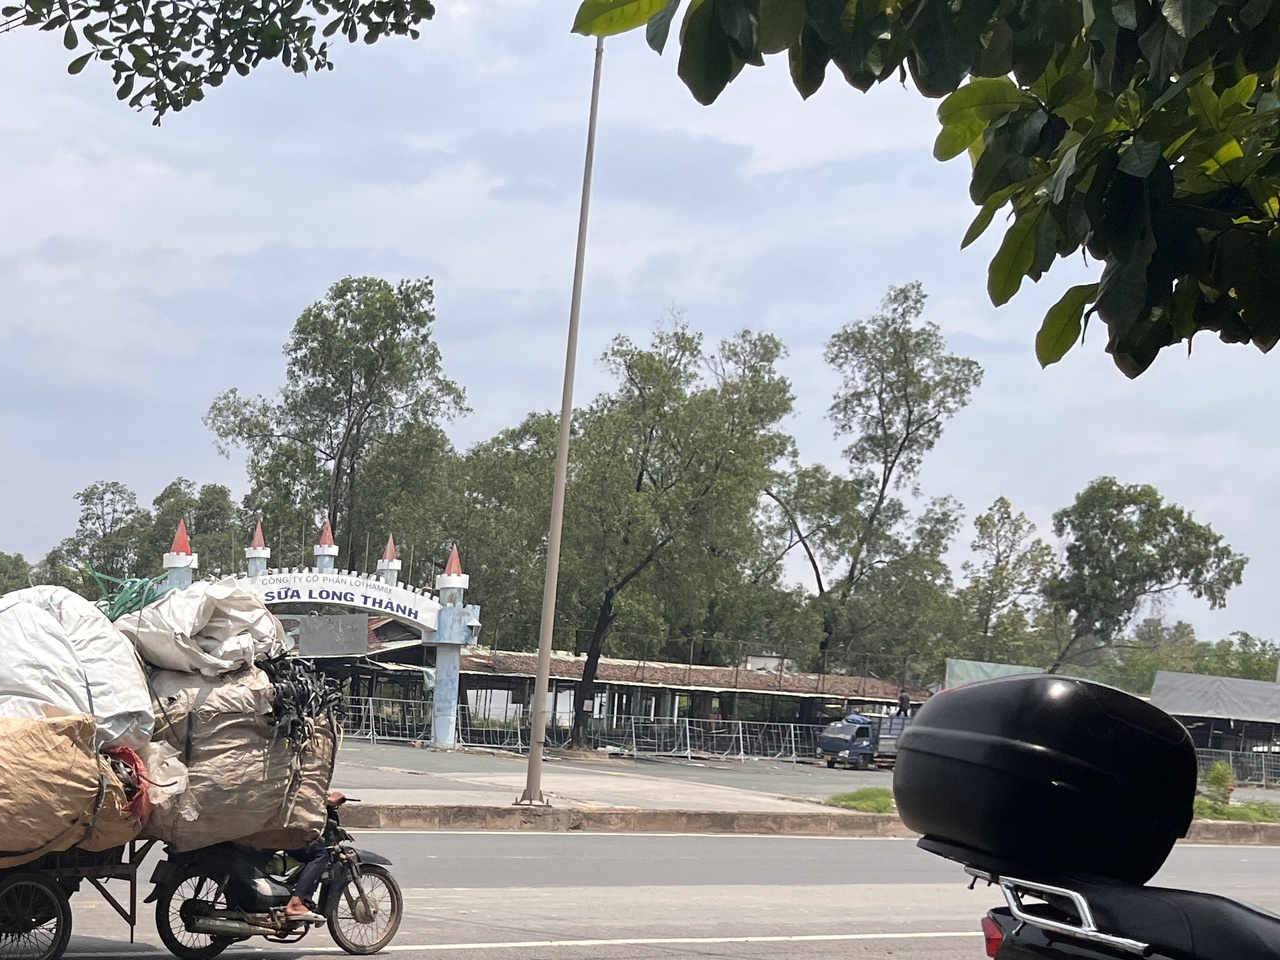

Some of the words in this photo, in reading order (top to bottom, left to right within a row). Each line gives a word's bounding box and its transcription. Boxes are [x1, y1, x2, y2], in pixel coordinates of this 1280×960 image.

[262, 576, 289, 586] CÔNG
[306, 575, 319, 583] CỔ
[349, 579, 392, 594] LOTHAMILK
[264, 586, 301, 602] SỮA
[361, 594, 419, 619] THÀNH
